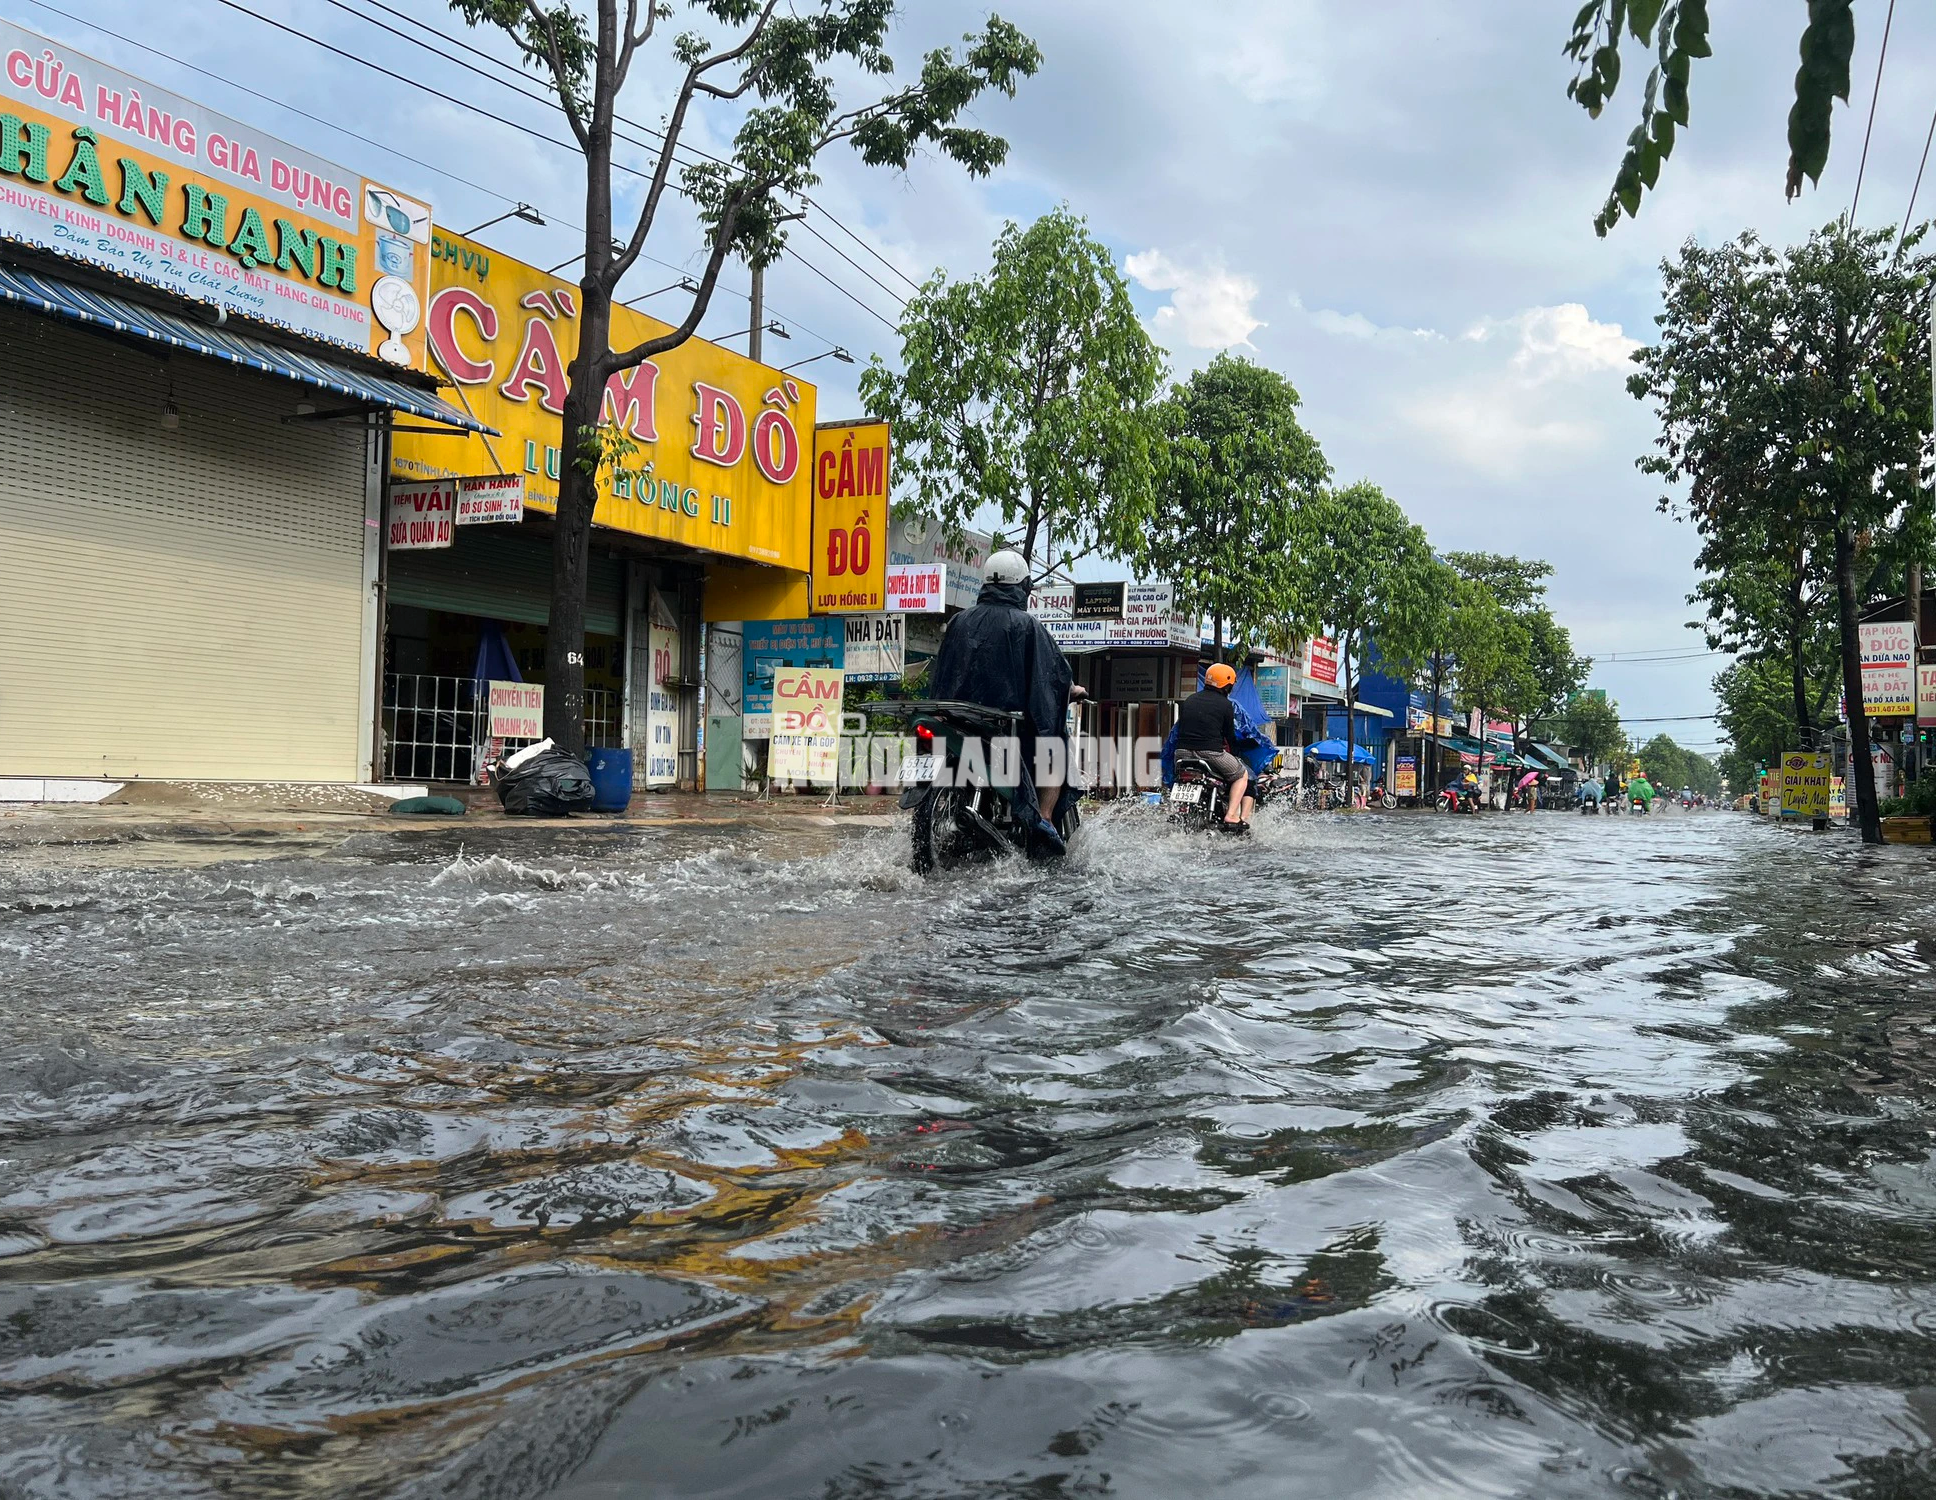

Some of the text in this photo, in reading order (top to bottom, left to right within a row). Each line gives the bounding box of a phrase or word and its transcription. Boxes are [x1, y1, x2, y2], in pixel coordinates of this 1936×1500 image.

[6, 47, 353, 220] CỬA HÀNG GIA DỤNG
[0, 112, 360, 294] HÂN HẠNH
[64, 208, 101, 233] KINH
[106, 224, 155, 252] DOANH
[177, 249, 188, 263] &
[213, 261, 240, 281] CÁC
[244, 271, 271, 292] MẶT
[275, 282, 308, 305] HÀNG
[311, 295, 330, 312] GIA
[333, 303, 365, 323] DỤNG
[131, 251, 154, 270] Uy
[690, 380, 801, 484] ĐỒ
[818, 431, 885, 500] CẦM
[412, 485, 452, 512] VẢI
[484, 500, 502, 513] SINH
[437, 516, 450, 543] ÁO
[826, 510, 871, 577] ĐỒ
[817, 592, 837, 607] LƯU
[839, 590, 868, 606] HỒNG
[1085, 597, 1113, 605] LAPTOP
[1142, 594, 1154, 602] CAO
[1155, 592, 1168, 602] CẤP
[1102, 605, 1120, 613] TÍNH
[1145, 604, 1157, 613] YU
[845, 613, 902, 643] NHÀ ĐẤT
[1126, 617, 1139, 626] GIA
[1141, 614, 1163, 625] PHÁT
[1108, 627, 1132, 640] THIỆN
[1870, 636, 1910, 651] ĐỨC
[776, 670, 840, 700] CẦM
[494, 717, 537, 736] NHANH 24h
[784, 703, 827, 732] ĐỒ
[791, 736, 802, 747] XE
[786, 769, 816, 778] MOMO
[1804, 774, 1827, 786] KHÁT
